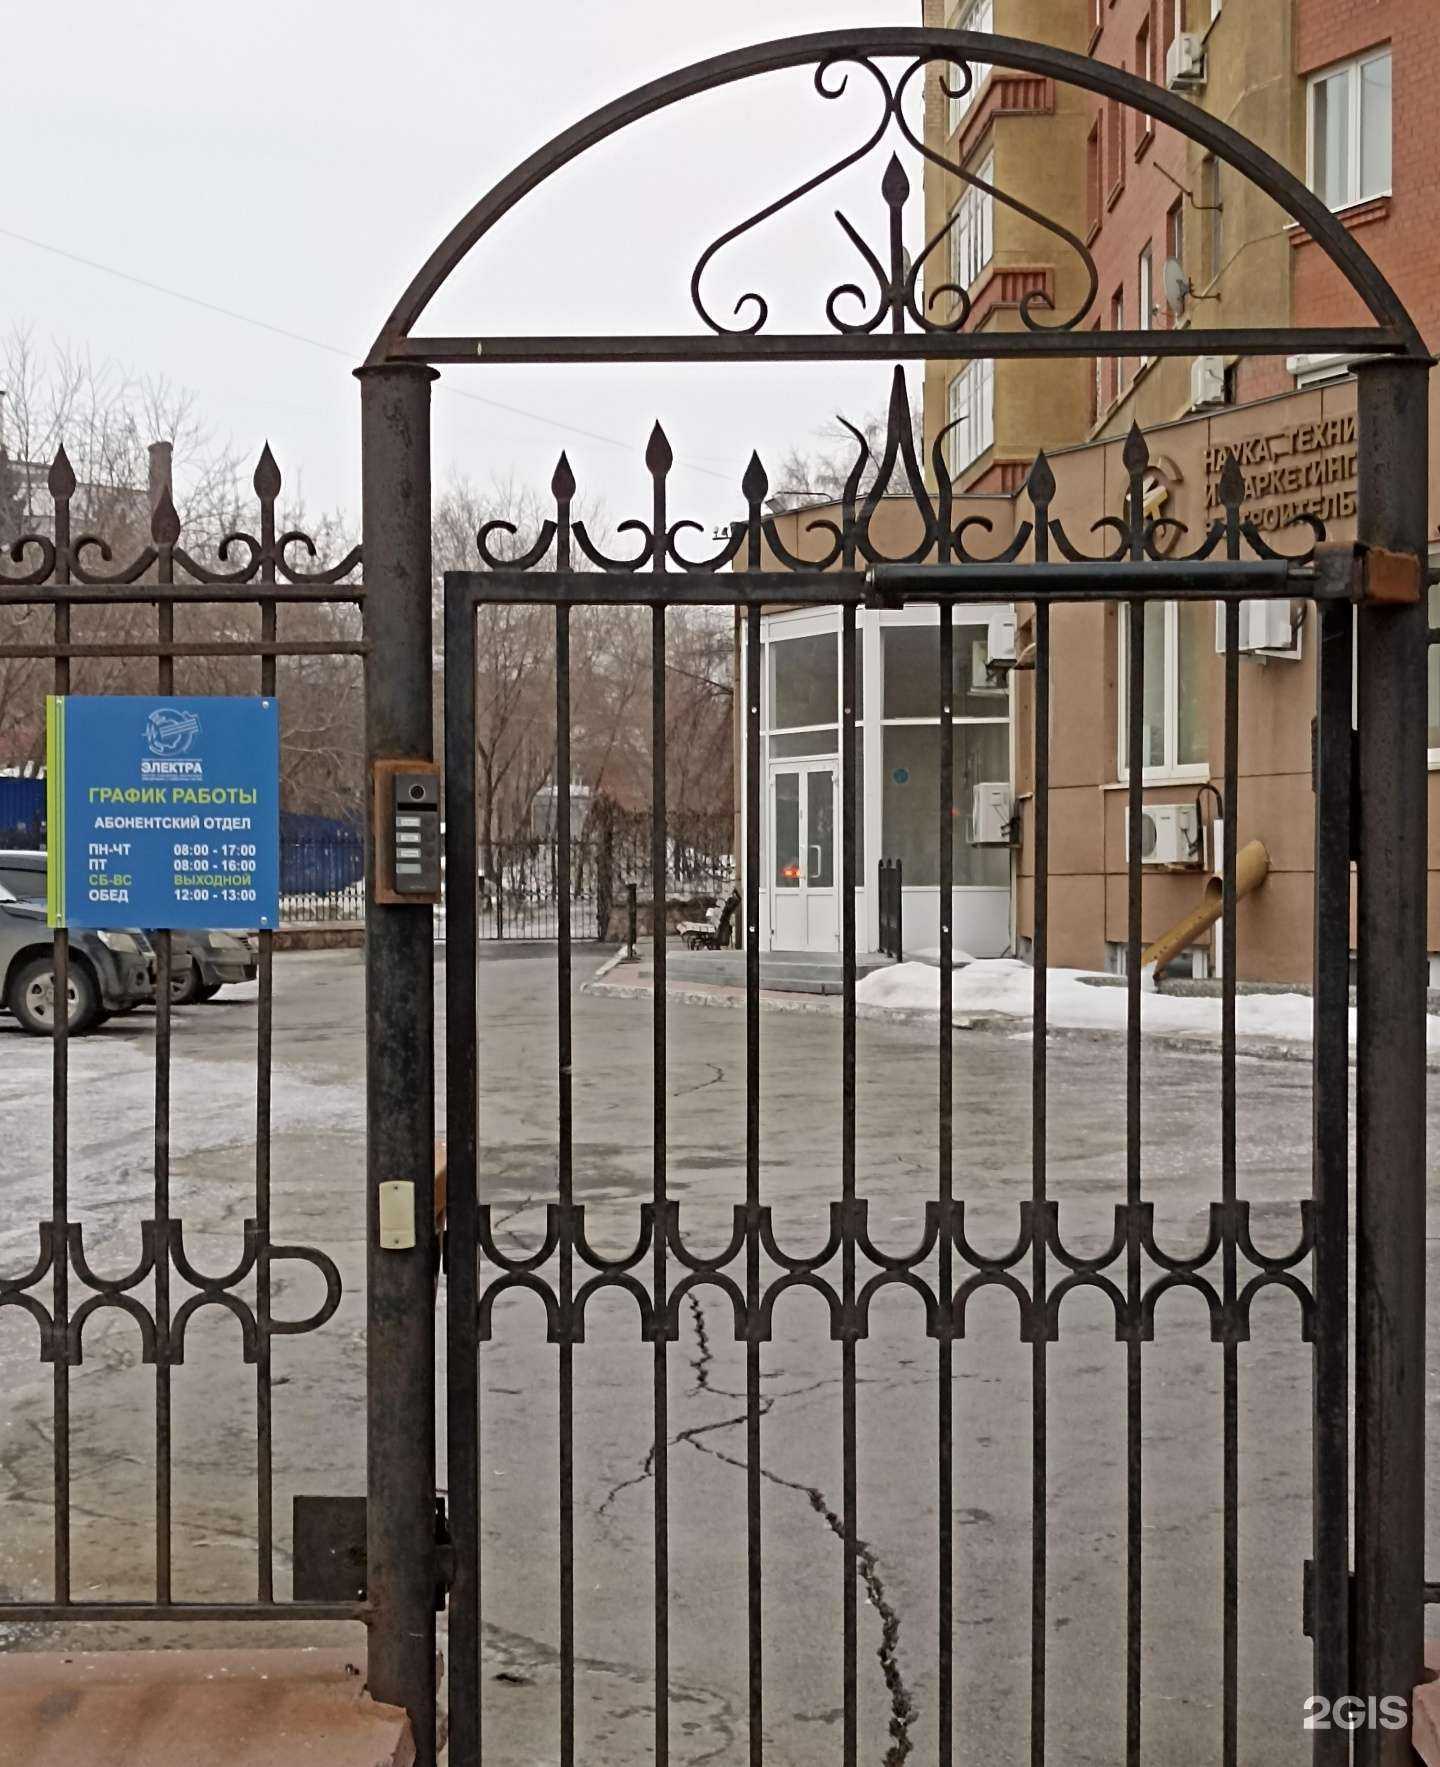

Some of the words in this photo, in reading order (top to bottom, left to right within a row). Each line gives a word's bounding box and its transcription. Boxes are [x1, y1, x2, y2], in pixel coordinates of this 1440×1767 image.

[1225, 454, 1357, 499] АРКЕТИНГ
[141, 761, 203, 774] ЭЛЕКТРА
[88, 787, 167, 804] ГРАФИК
[173, 788, 257, 804] РАБОТЫ
[94, 815, 200, 830] АБОНЕНТСКИЙ
[203, 817, 251, 831] ОТДЕЛ
[88, 843, 131, 856] ПН-ЧТ
[173, 844, 209, 856] 08:00
[222, 844, 256, 856] 17:00
[88, 859, 107, 871] ПТ
[173, 860, 209, 872] 08:00
[222, 860, 256, 872] 16:00
[88, 874, 133, 886] СБ-ВС
[174, 873, 252, 887] ВЫХОДНОЙ
[88, 890, 129, 903] ОБЕД
[174, 890, 209, 901] 12:00
[222, 890, 256, 901] 13:00
